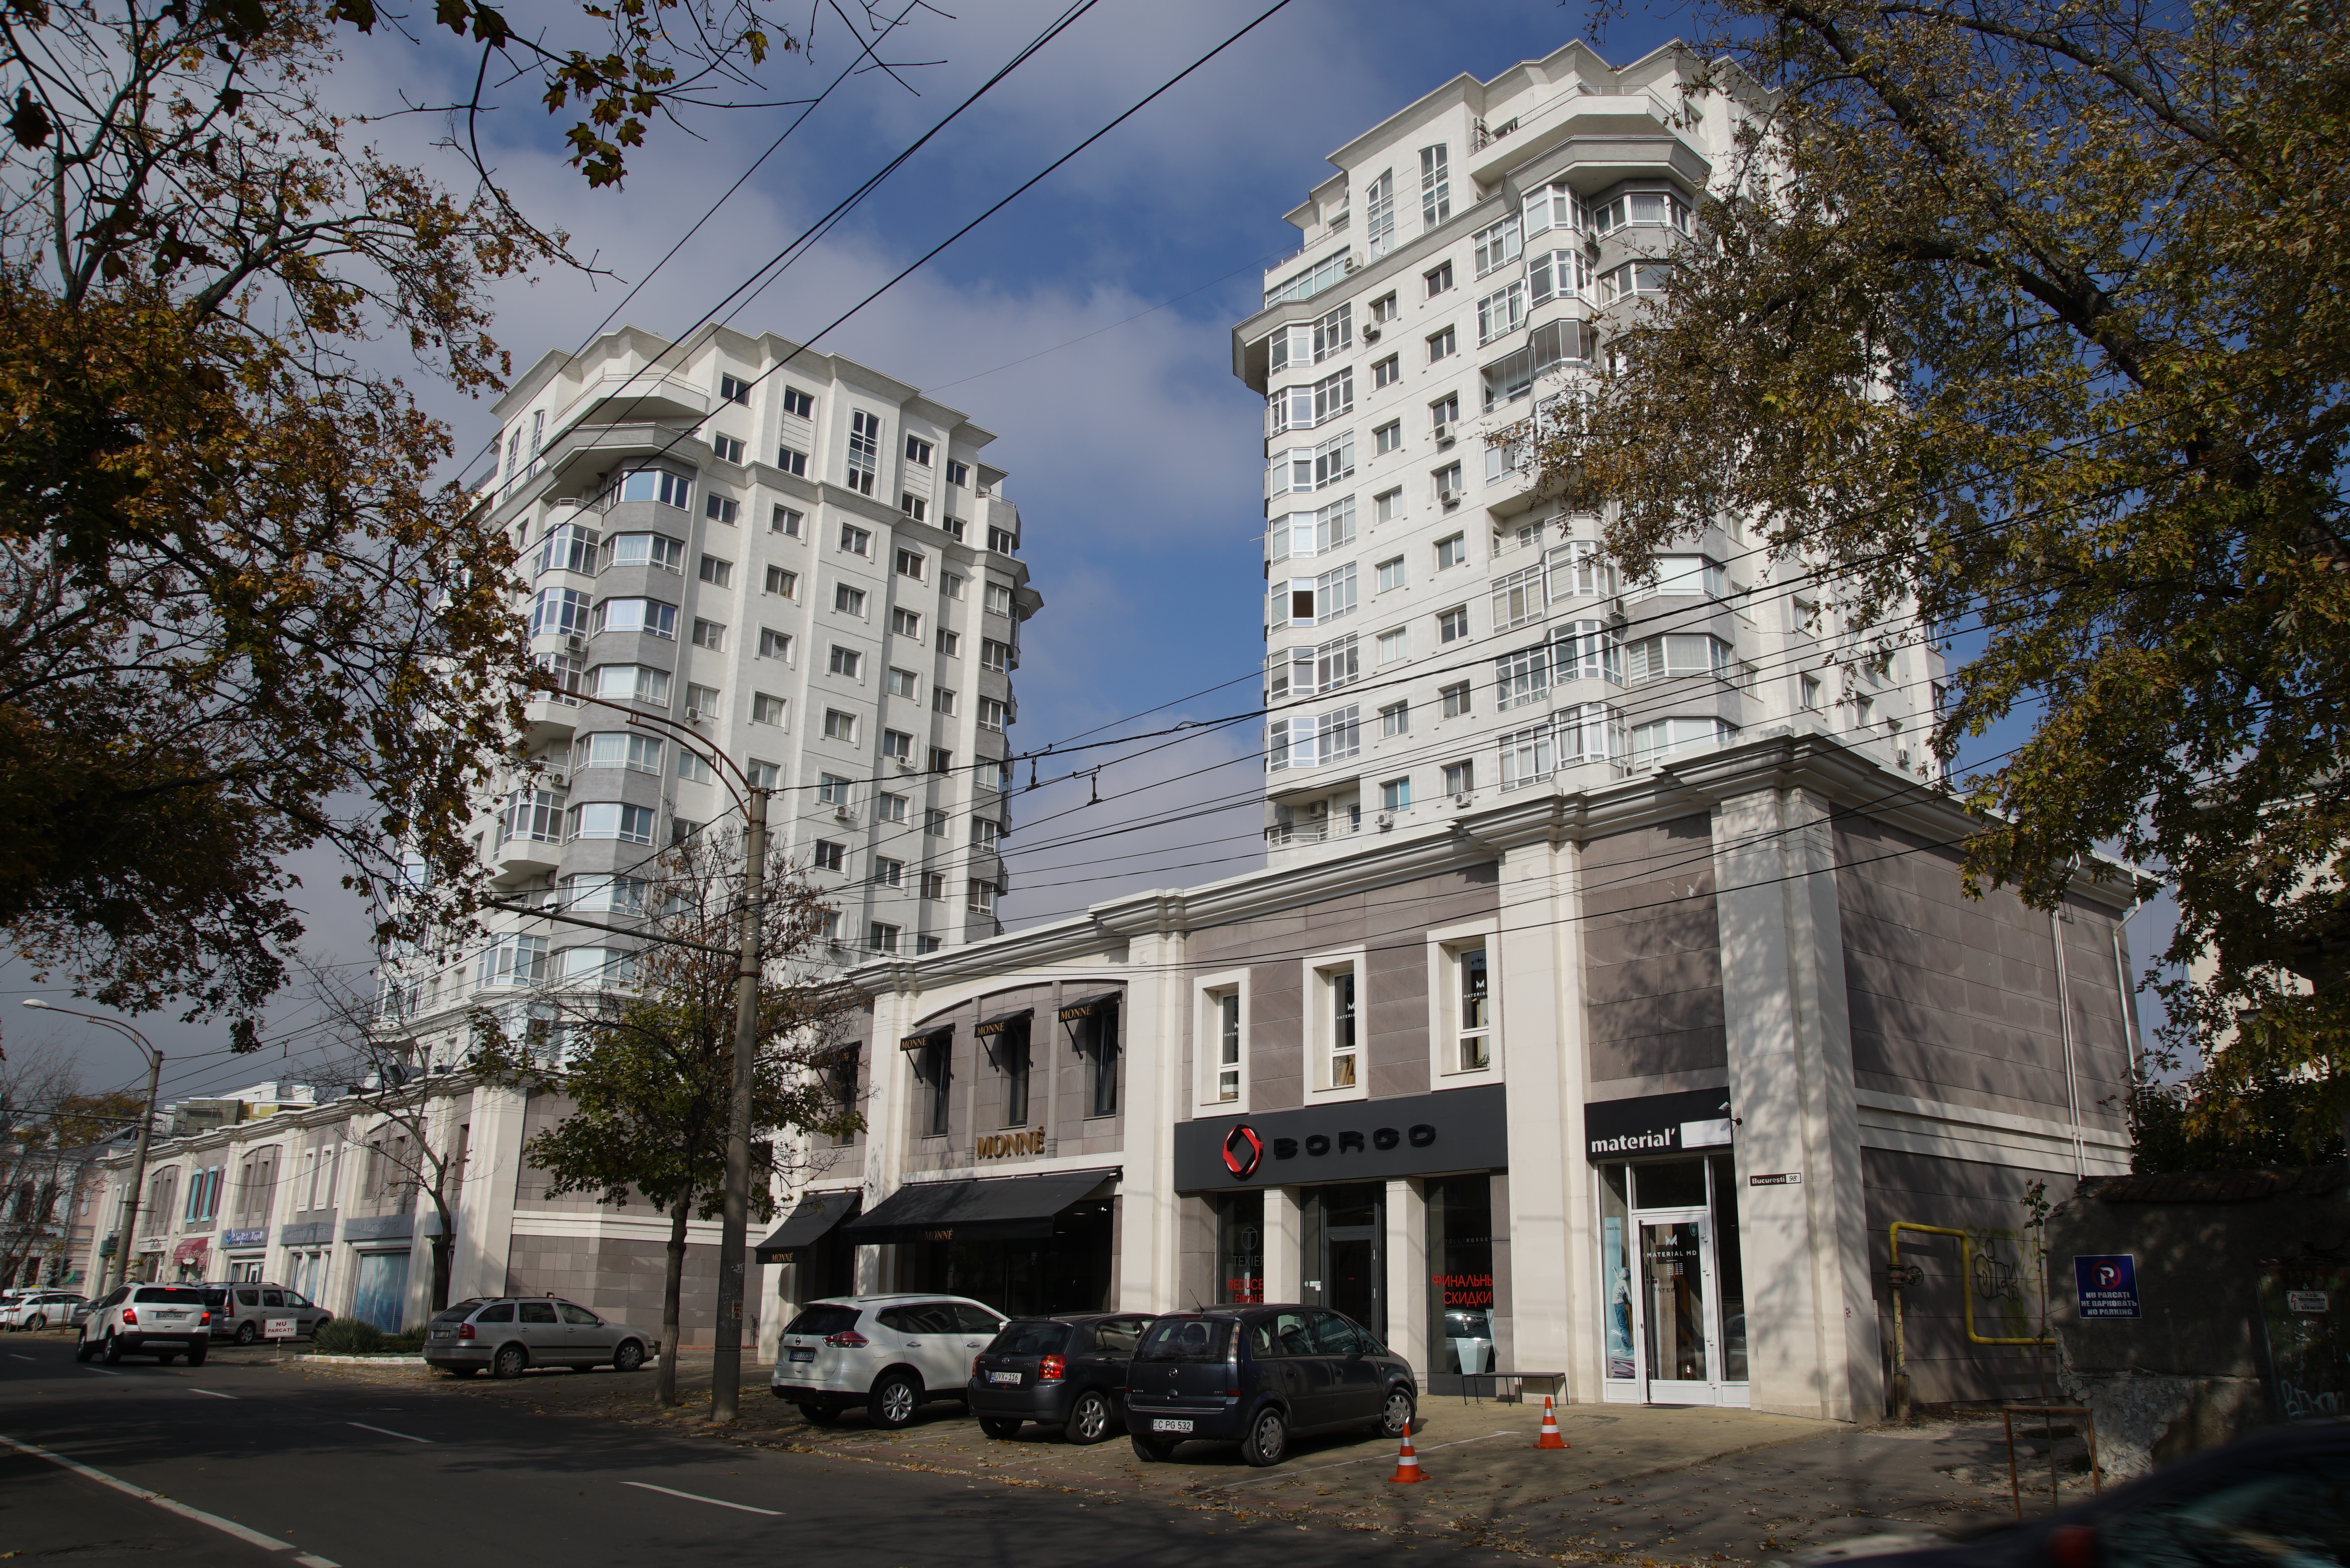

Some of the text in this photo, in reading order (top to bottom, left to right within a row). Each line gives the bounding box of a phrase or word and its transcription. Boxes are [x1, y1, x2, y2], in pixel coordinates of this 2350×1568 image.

[1060, 1004, 1091, 1020] MONNÉ
[977, 1020, 1005, 1035] MONNÉ
[901, 1035, 926, 1049] MONNÉ
[976, 1126, 1045, 1159] MONNÉ
[1274, 1124, 1436, 1160] BORGO
[925, 1228, 953, 1240] MONNÉ
[772, 1251, 793, 1262] MONNÉ
[1228, 1279, 1264, 1290] REDUCE
[1443, 1291, 1492, 1307] СКИДКИ
[1158, 1420, 1190, 1430] C PG 532
